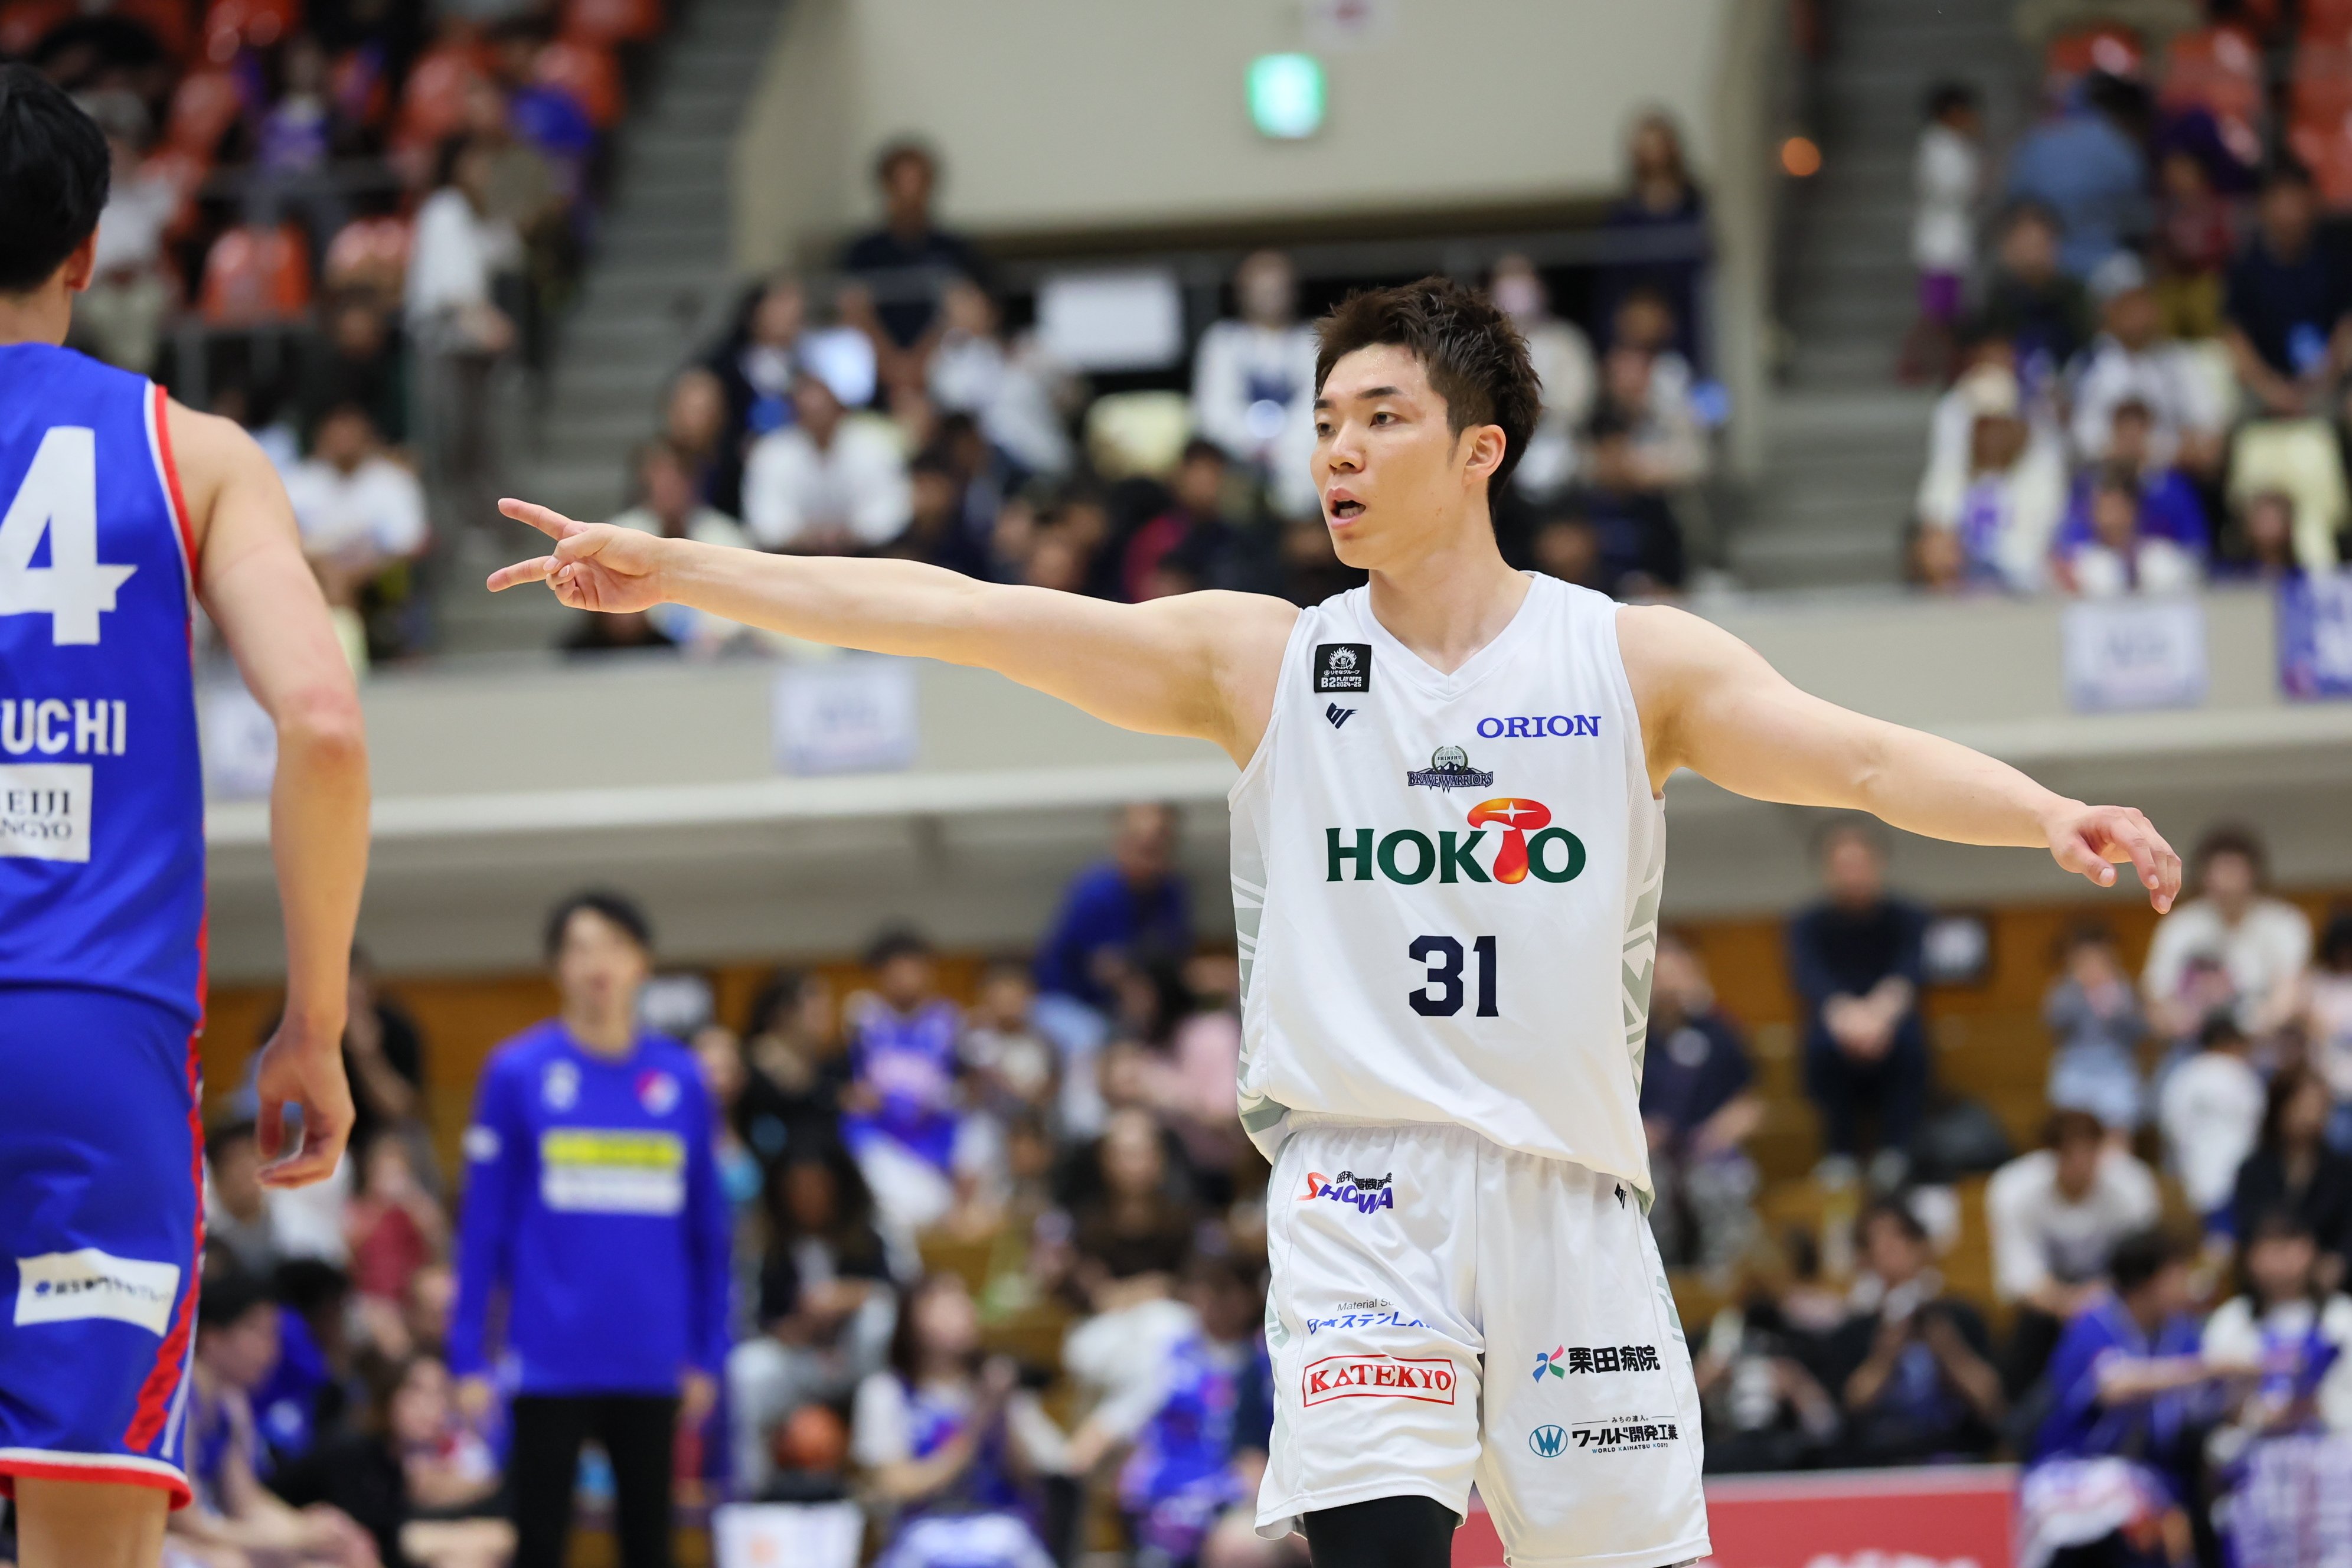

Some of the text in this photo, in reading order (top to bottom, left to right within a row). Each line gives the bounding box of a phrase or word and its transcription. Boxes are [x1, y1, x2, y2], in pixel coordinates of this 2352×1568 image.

[1321, 677, 1336, 688] B2
[1476, 715, 1601, 738] ORION
[1326, 798, 1586, 885] HOKTO
[1409, 935, 1499, 1017] 31
[1296, 1172, 1393, 1214] SHOWA
[1337, 1299, 1377, 1312] Material
[1568, 1345, 1660, 1374] 栗田病院
[1310, 1364, 1451, 1394] KATEKYO
[1611, 1415, 1649, 1423] みちの達人。
[1572, 1424, 1679, 1448] ワールド開発工業
